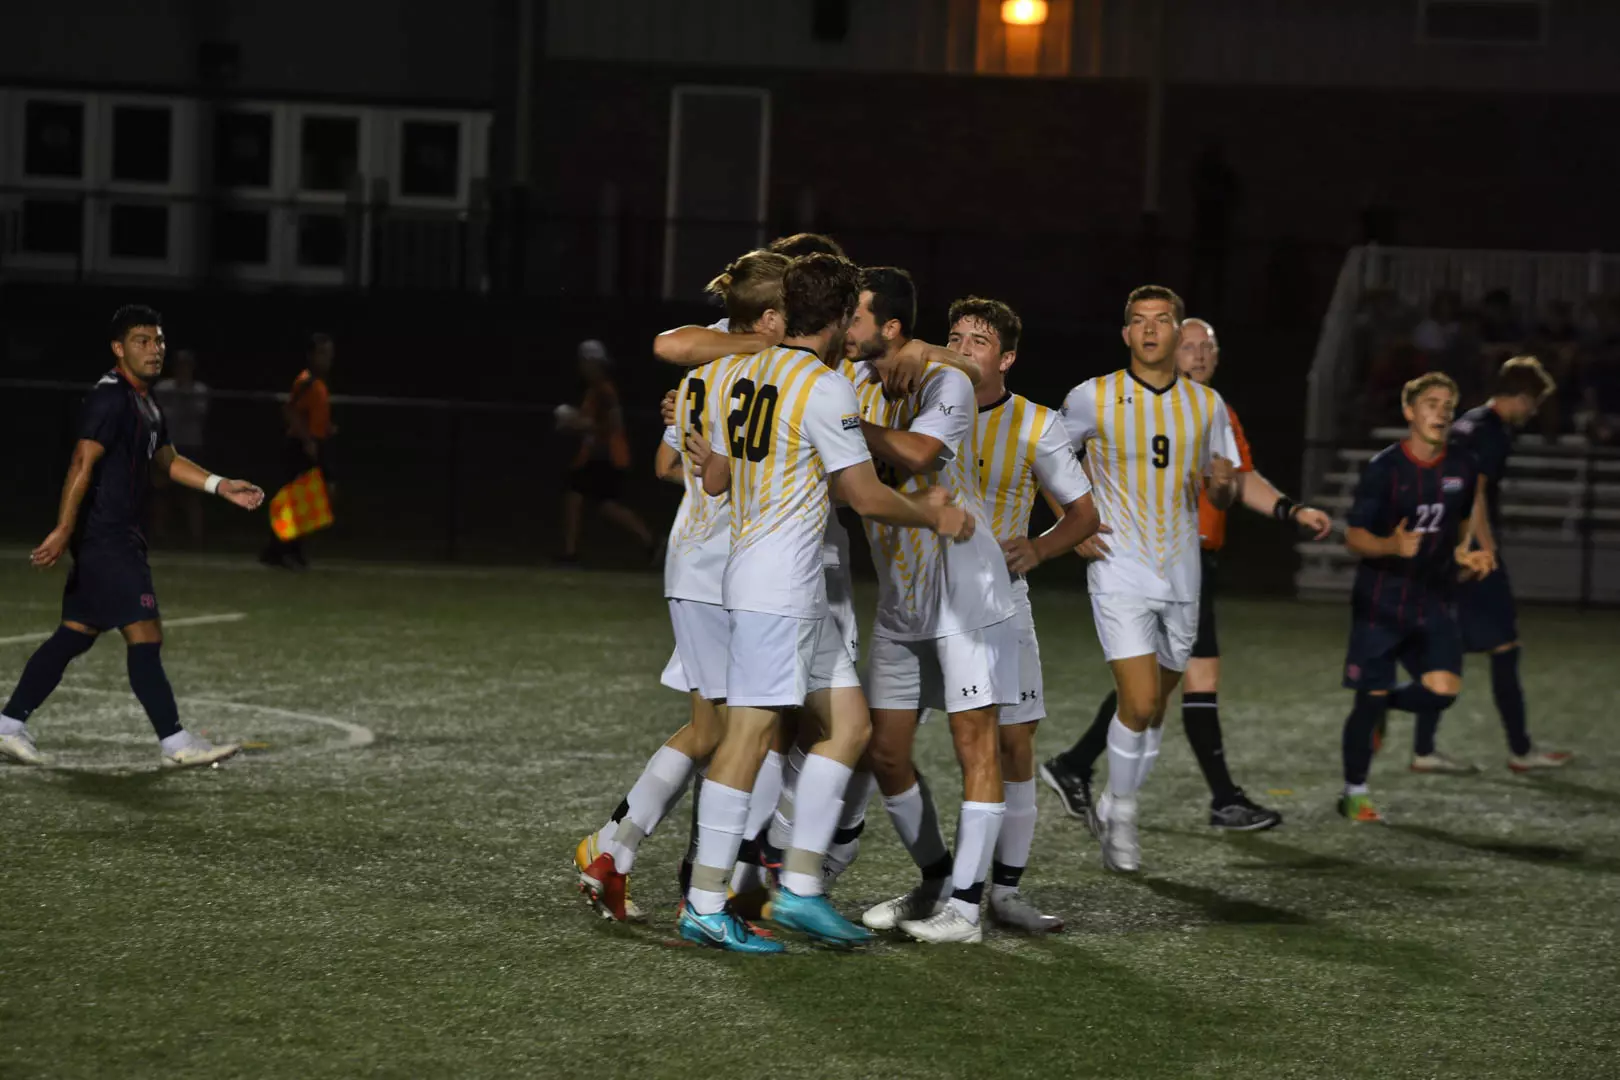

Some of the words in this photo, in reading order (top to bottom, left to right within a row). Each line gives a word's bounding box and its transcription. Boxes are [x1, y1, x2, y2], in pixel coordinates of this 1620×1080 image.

[727, 377, 778, 462] 20
[1152, 434, 1170, 468] 9
[1413, 503, 1446, 533] 22
